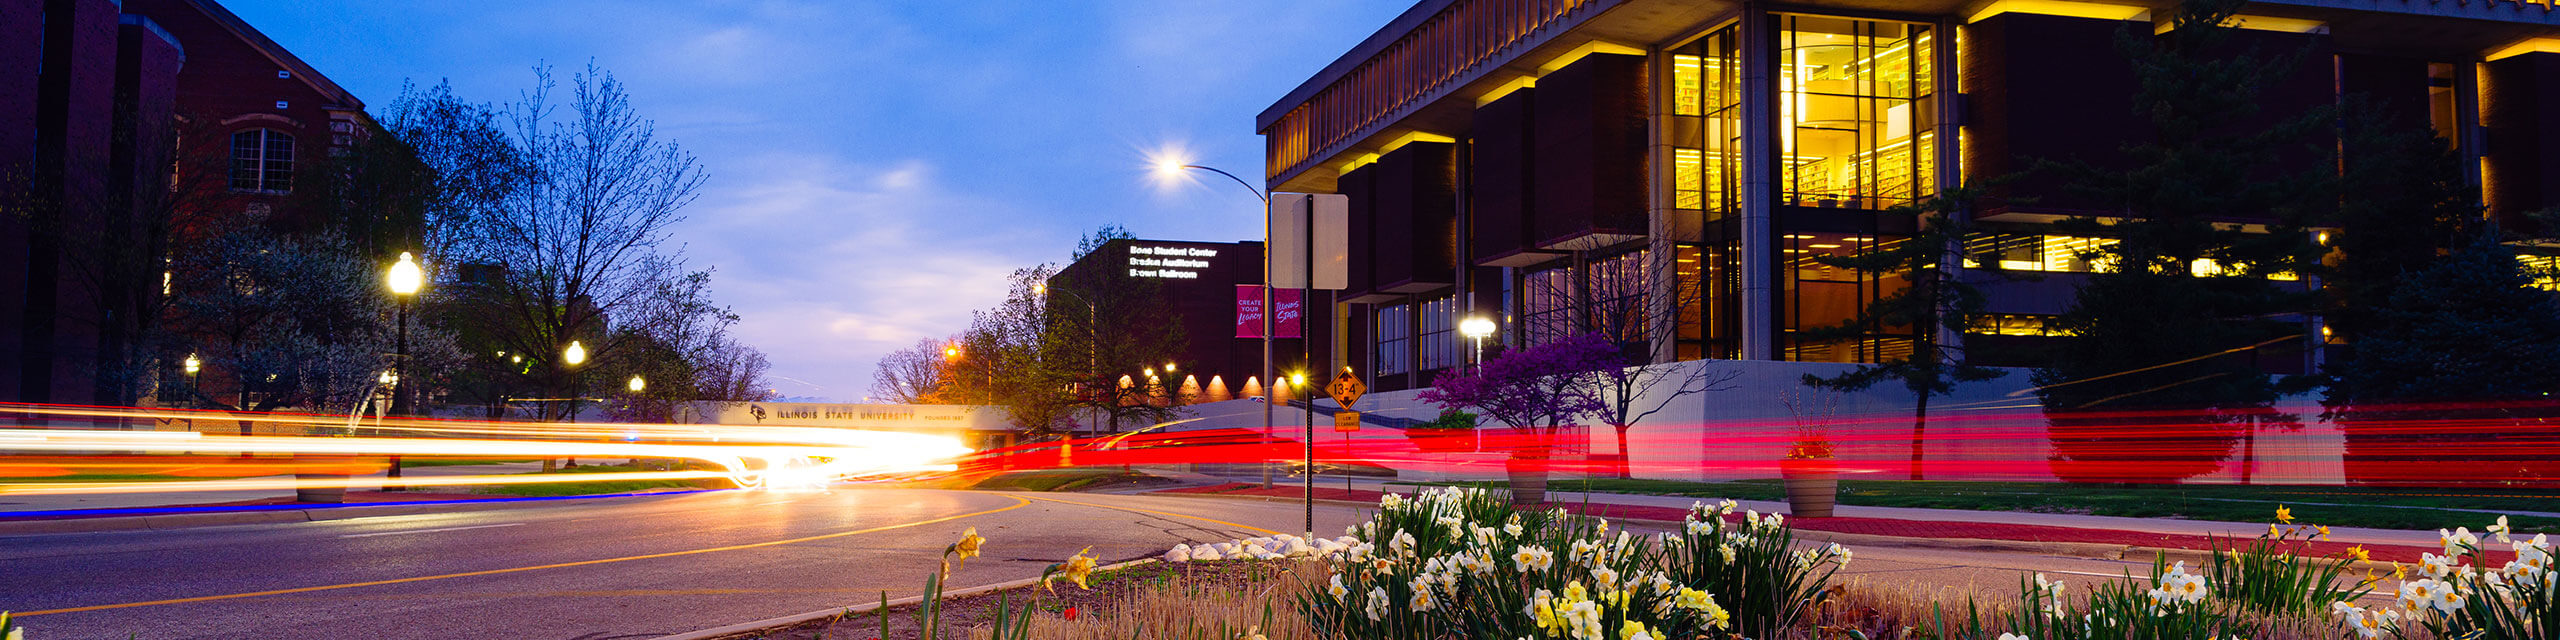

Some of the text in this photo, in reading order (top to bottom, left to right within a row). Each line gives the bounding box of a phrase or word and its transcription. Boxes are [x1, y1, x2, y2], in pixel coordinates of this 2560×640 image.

[1154, 247, 1187, 256] Student
[1188, 248, 1217, 257] Center
[1162, 259, 1209, 268] Auditorium
[1158, 269, 1198, 279] Ballroom
[777, 411, 914, 420] ILLINOIS STATE UNIVERSITY
